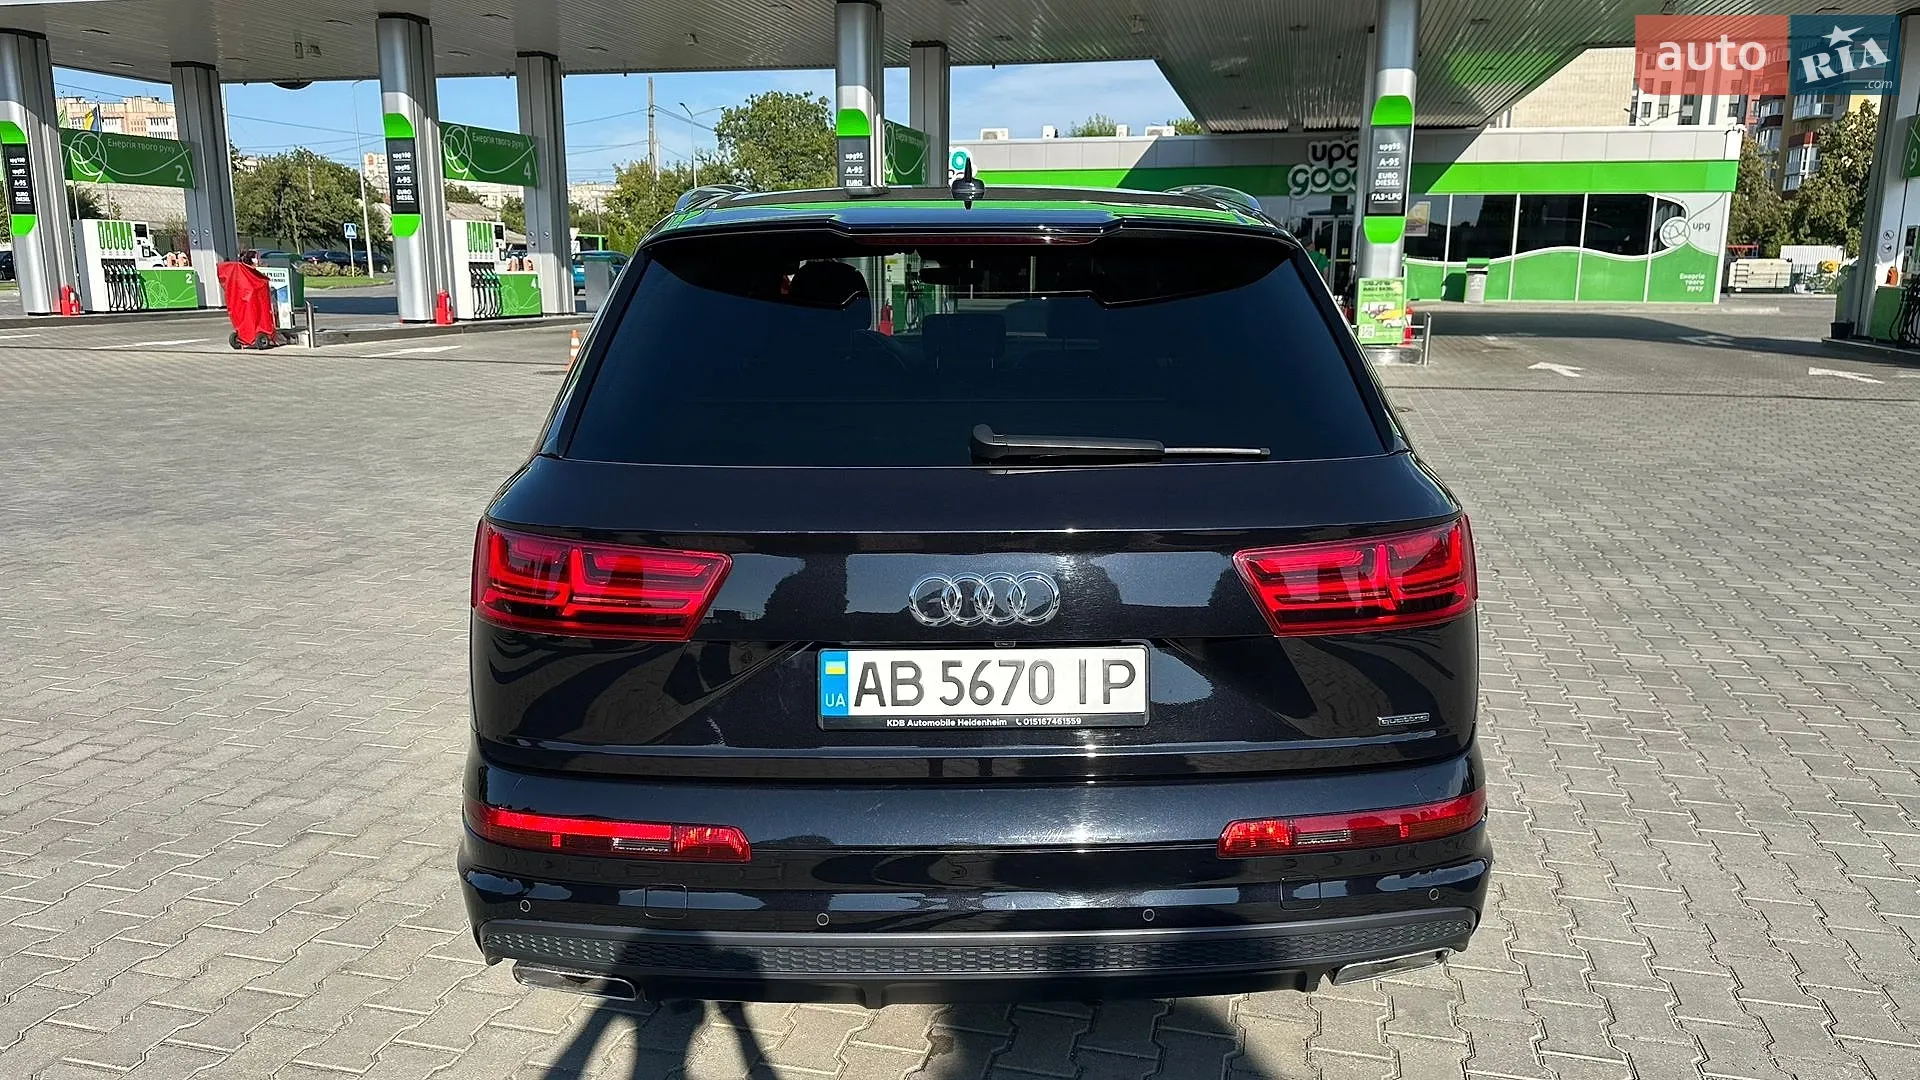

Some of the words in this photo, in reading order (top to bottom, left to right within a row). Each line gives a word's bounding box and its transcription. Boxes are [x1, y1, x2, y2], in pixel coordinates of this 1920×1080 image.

[108, 138, 136, 149] Енергія
[138, 143, 158, 151] твого
[160, 145, 175, 154] руху
[1379, 142, 1401, 152] upg95
[1379, 157, 1400, 167] A-95
[175, 164, 186, 182] 2
[523, 162, 532, 180] 4
[845, 166, 863, 174] A-95
[1291, 167, 1357, 196] goo
[1375, 179, 1400, 187] DIESEL
[1692, 222, 1711, 232] upg
[186, 273, 193, 284] 2
[854, 660, 925, 707] AB
[939, 659, 1055, 707] 5670
[1078, 658, 1136, 705] IP
[825, 693, 846, 707] UA
[886, 719, 906, 727] KDB
[906, 719, 956, 727] Automobile
[957, 718, 1007, 727] Heidenheim
